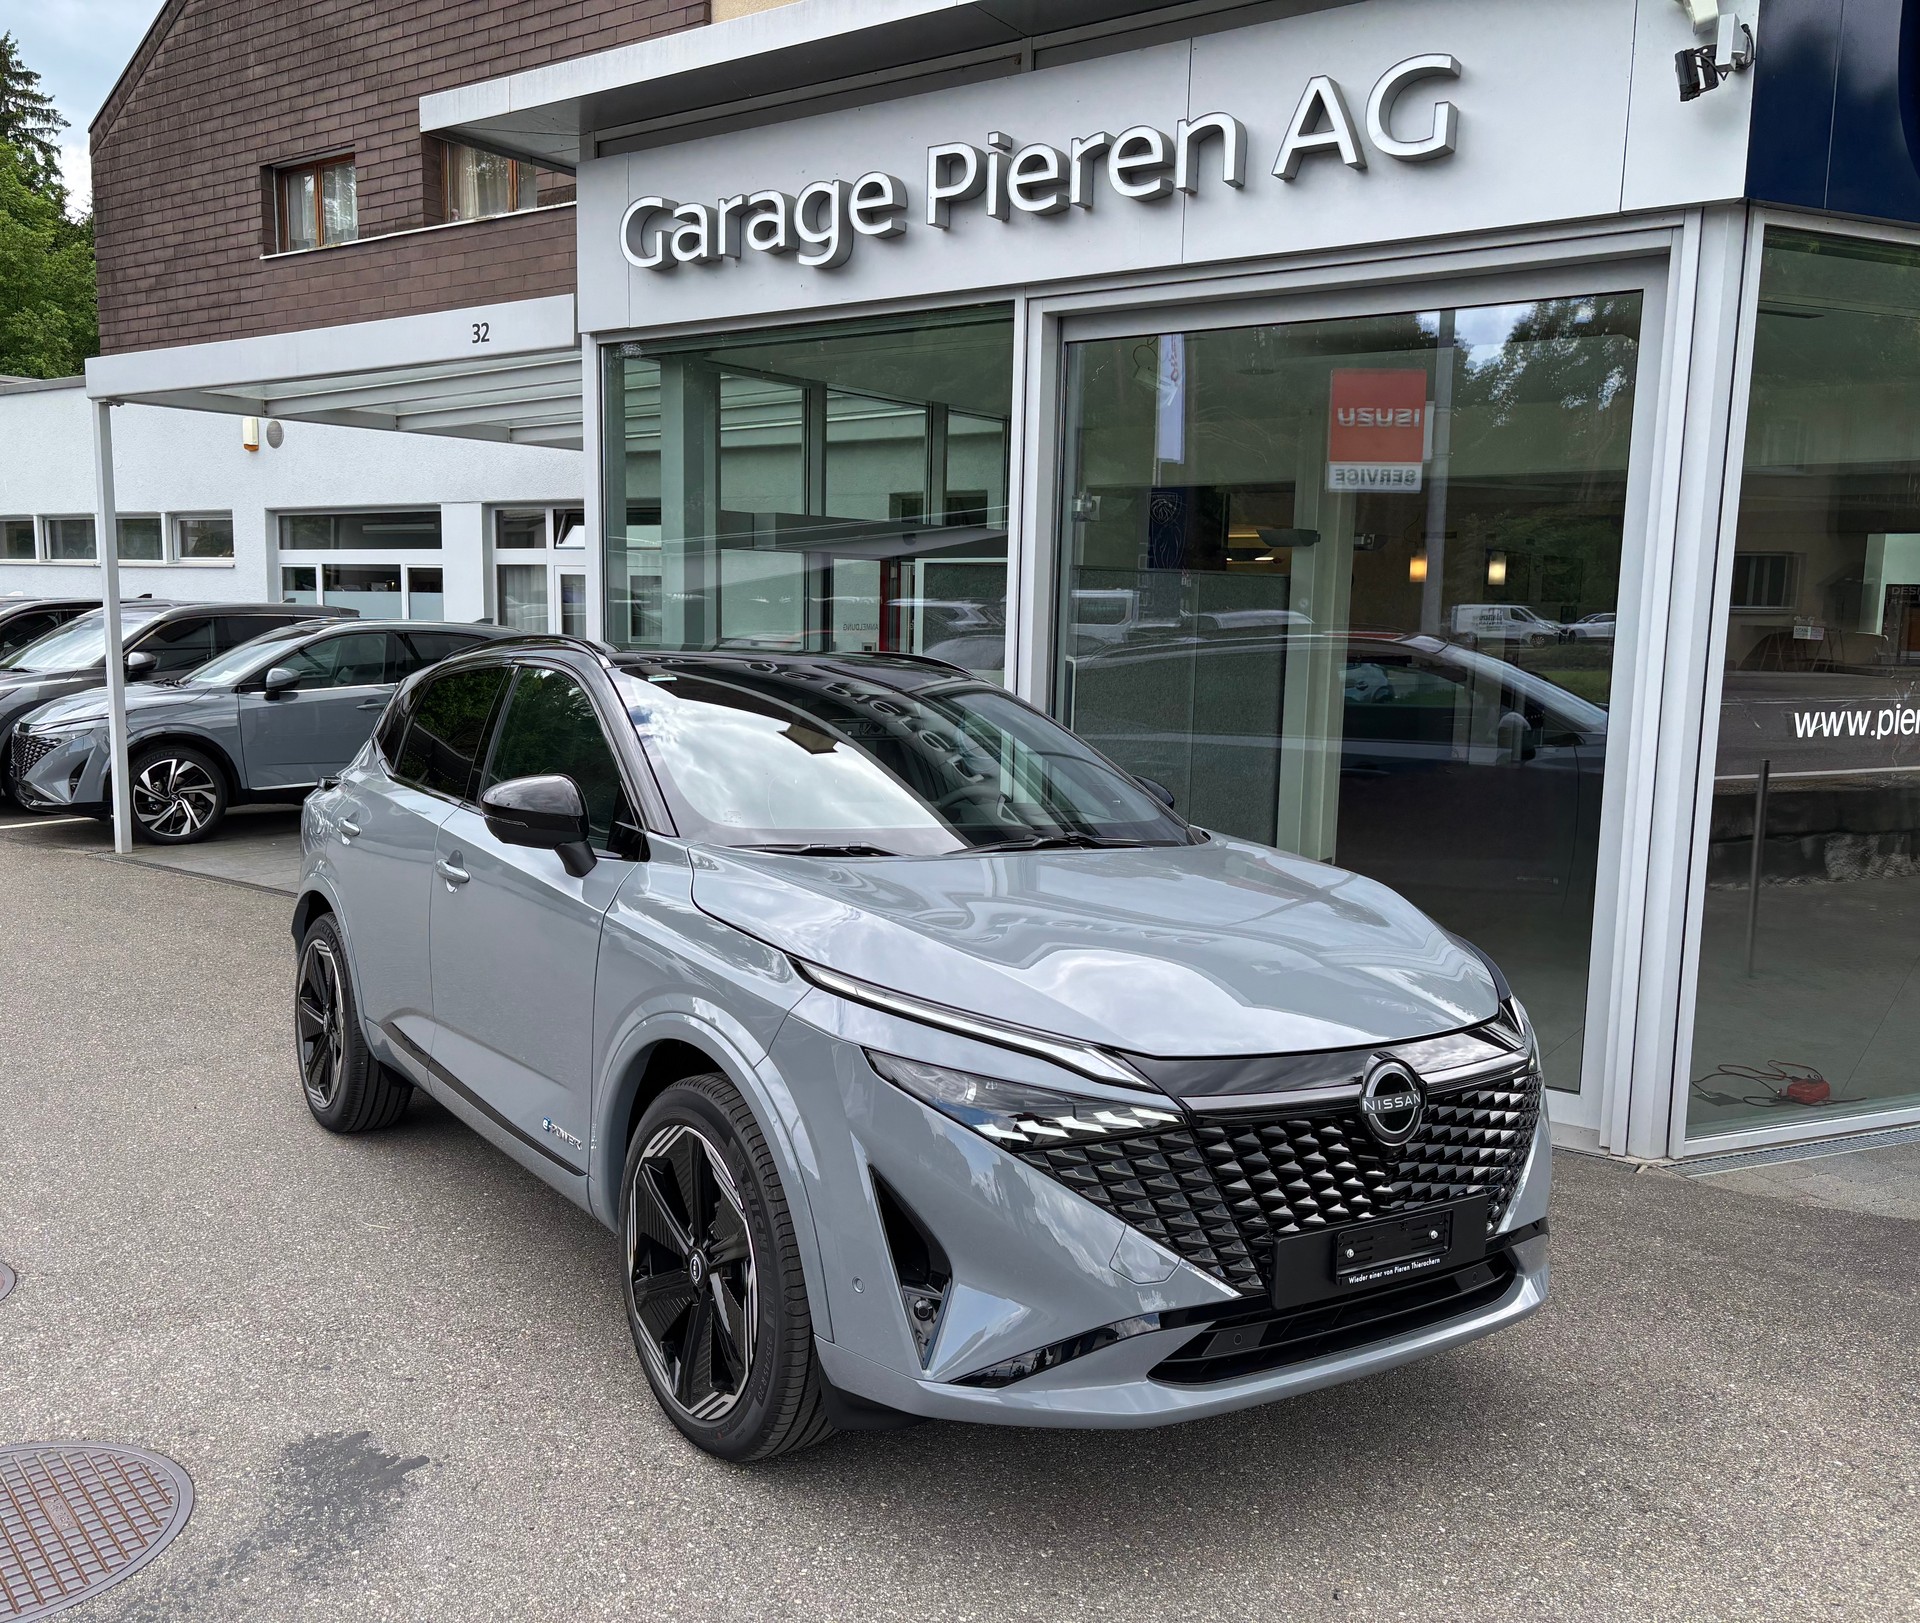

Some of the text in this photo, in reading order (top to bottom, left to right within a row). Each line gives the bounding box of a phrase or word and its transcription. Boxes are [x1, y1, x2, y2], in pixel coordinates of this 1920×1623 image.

[619, 53, 1462, 271] Garage Pieren AG
[472, 322, 490, 344] 32
[1362, 1093, 1421, 1112] NISSAN
[743, 1180, 776, 1329] MICHELIN
[1348, 1273, 1368, 1284] Wieder
[1369, 1270, 1383, 1280] einer
[1394, 1265, 1410, 1274] Pieren
[763, 1336, 773, 1377] 235/45
